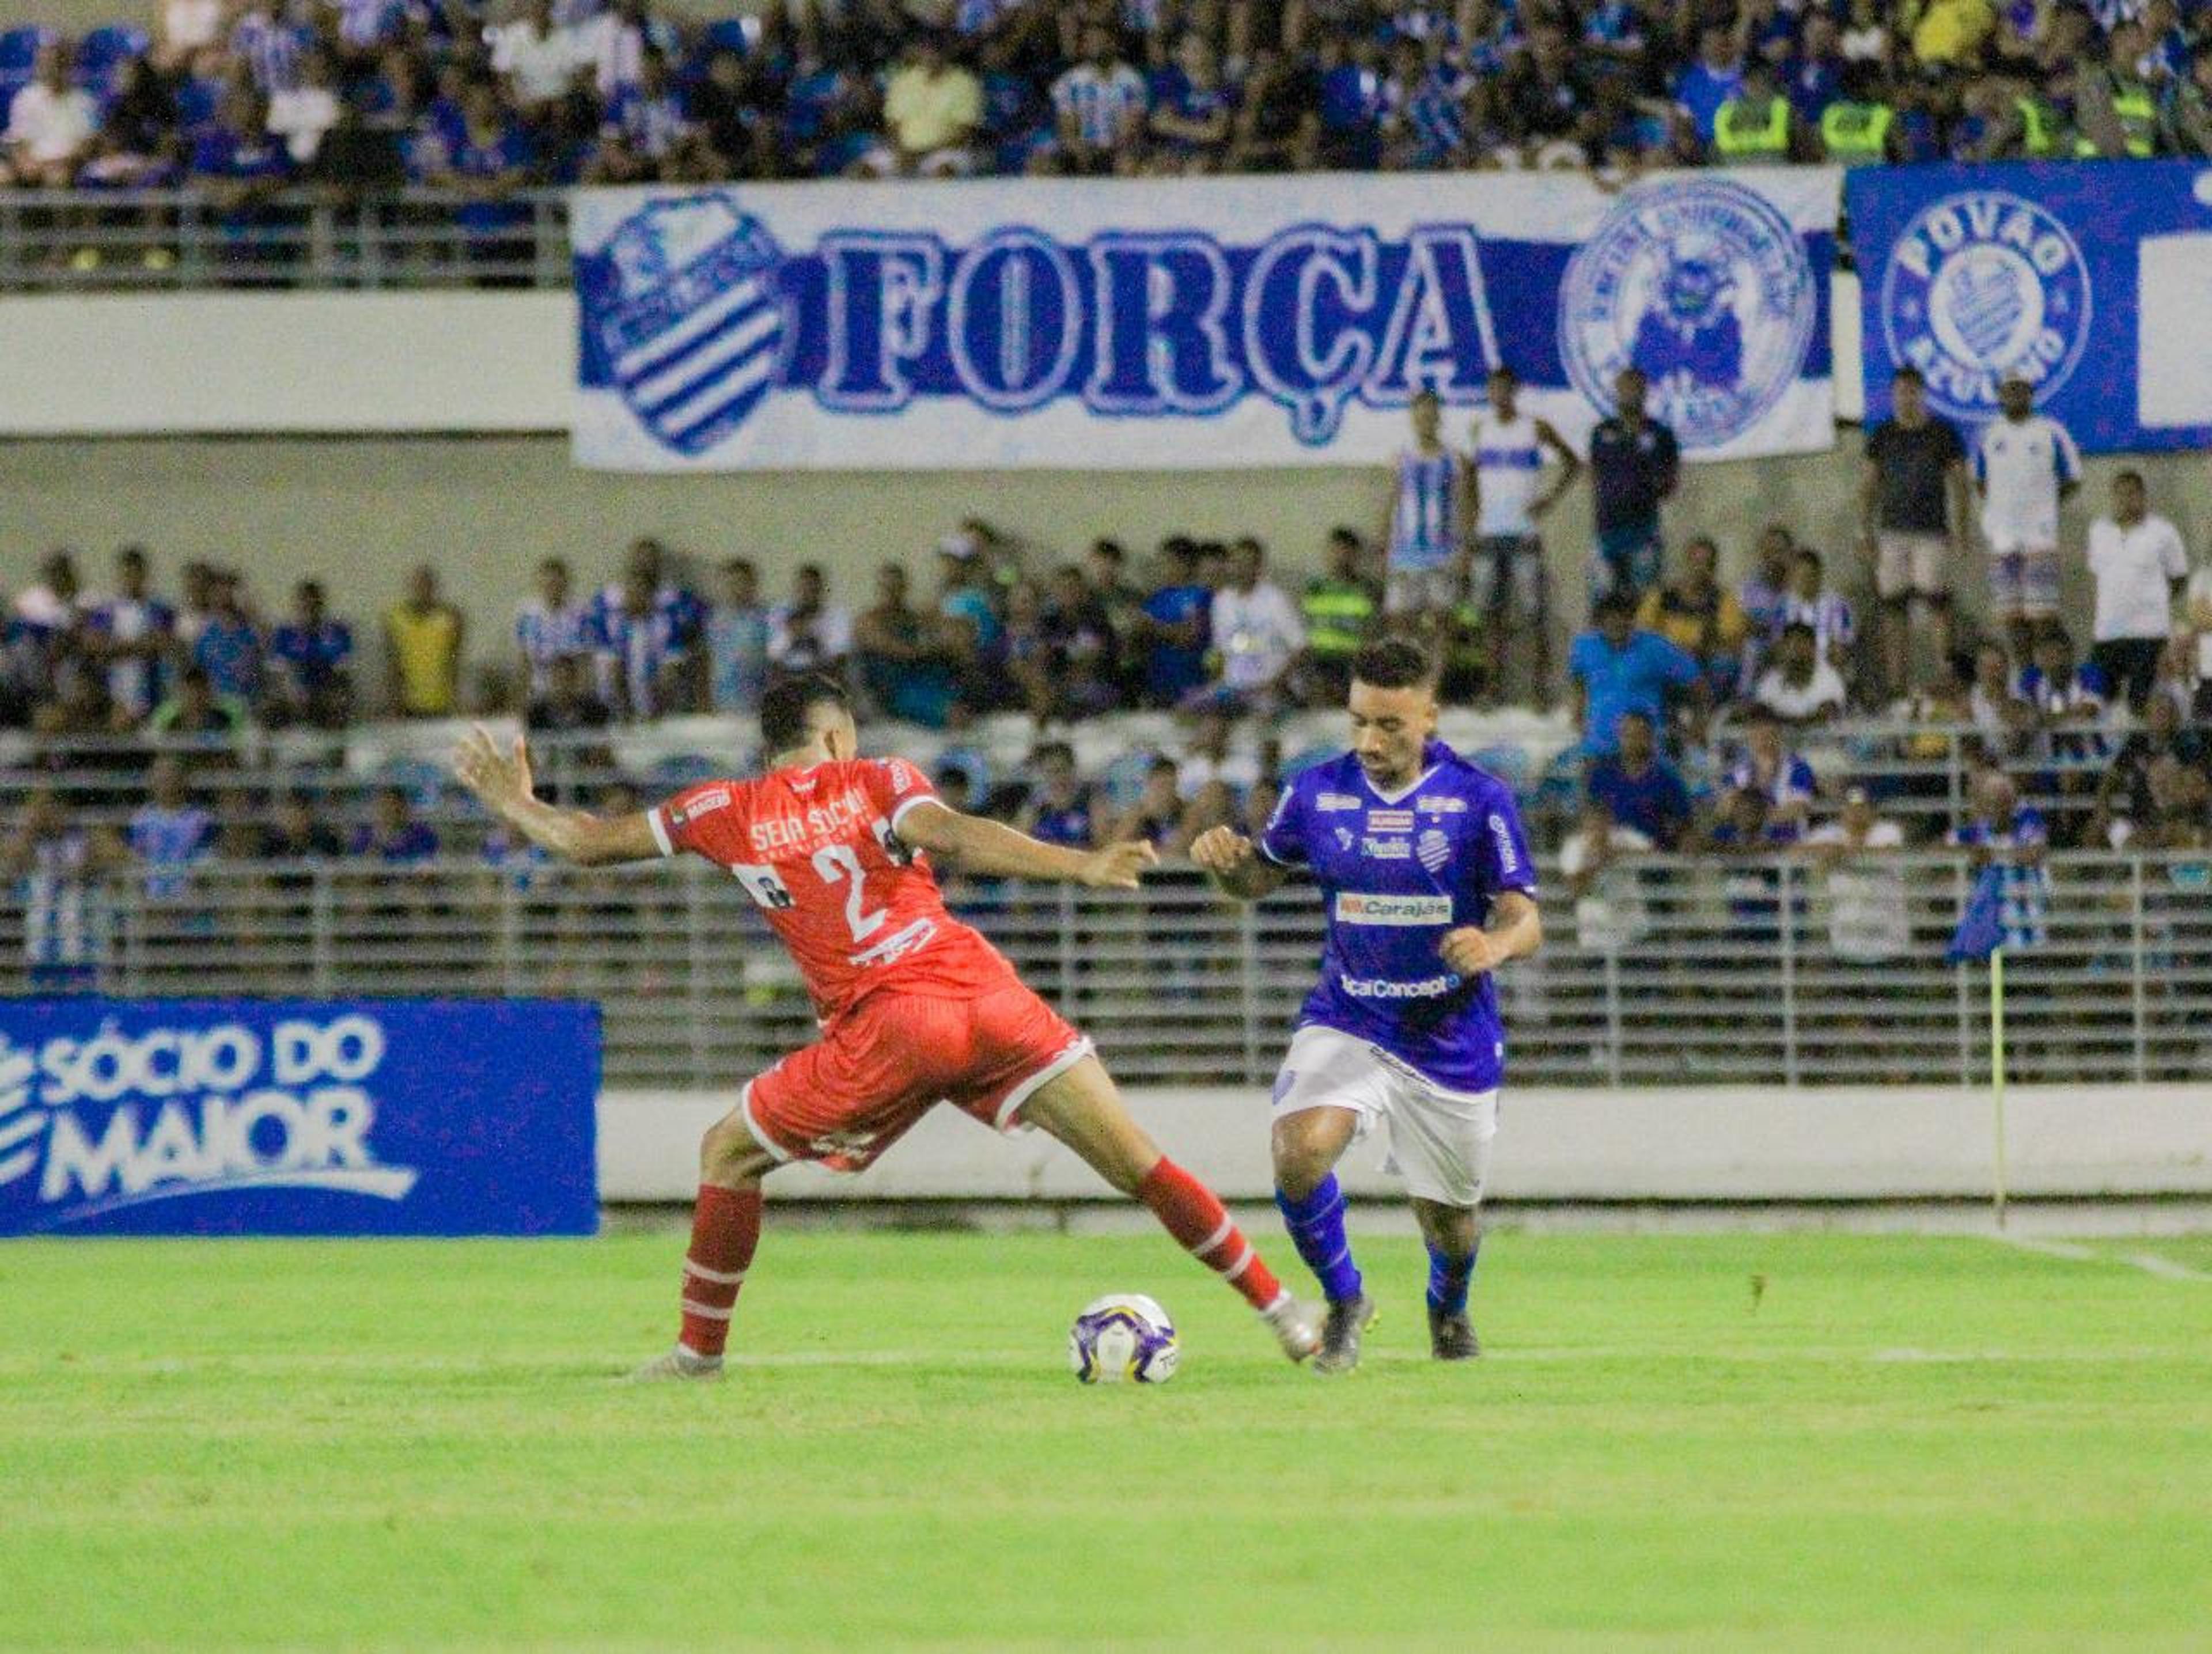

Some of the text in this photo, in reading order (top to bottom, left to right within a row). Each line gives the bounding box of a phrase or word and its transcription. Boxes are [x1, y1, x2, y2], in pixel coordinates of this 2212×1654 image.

[814, 224, 1500, 447] FORÇA
[812, 845, 888, 943] 2
[1366, 900, 1449, 918] Carajás
[40, 1015, 385, 1104] SÓCIO DO
[38, 1085, 377, 1203] MAIOR
